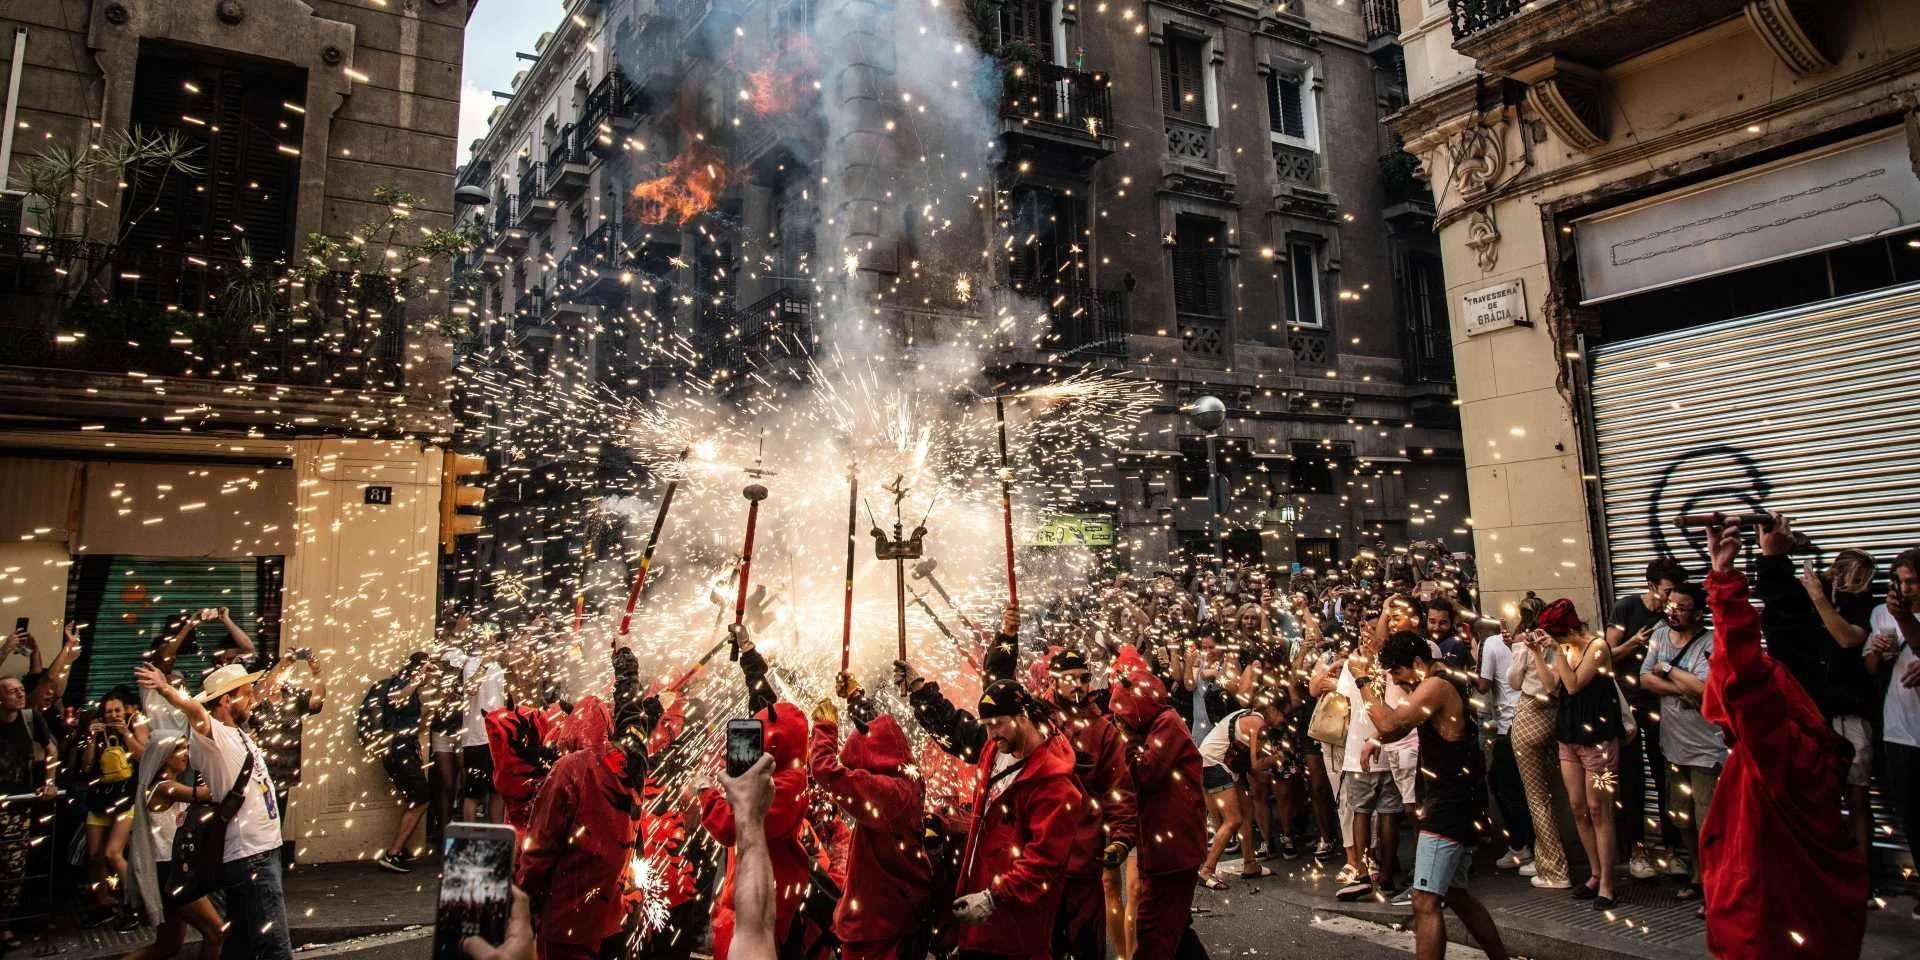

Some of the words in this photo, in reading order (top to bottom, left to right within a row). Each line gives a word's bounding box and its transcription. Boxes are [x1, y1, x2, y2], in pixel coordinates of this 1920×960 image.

[1467, 287, 1517, 305] TRAVESSERA
[1487, 302, 1498, 310] DE
[370, 488, 387, 502] 81
